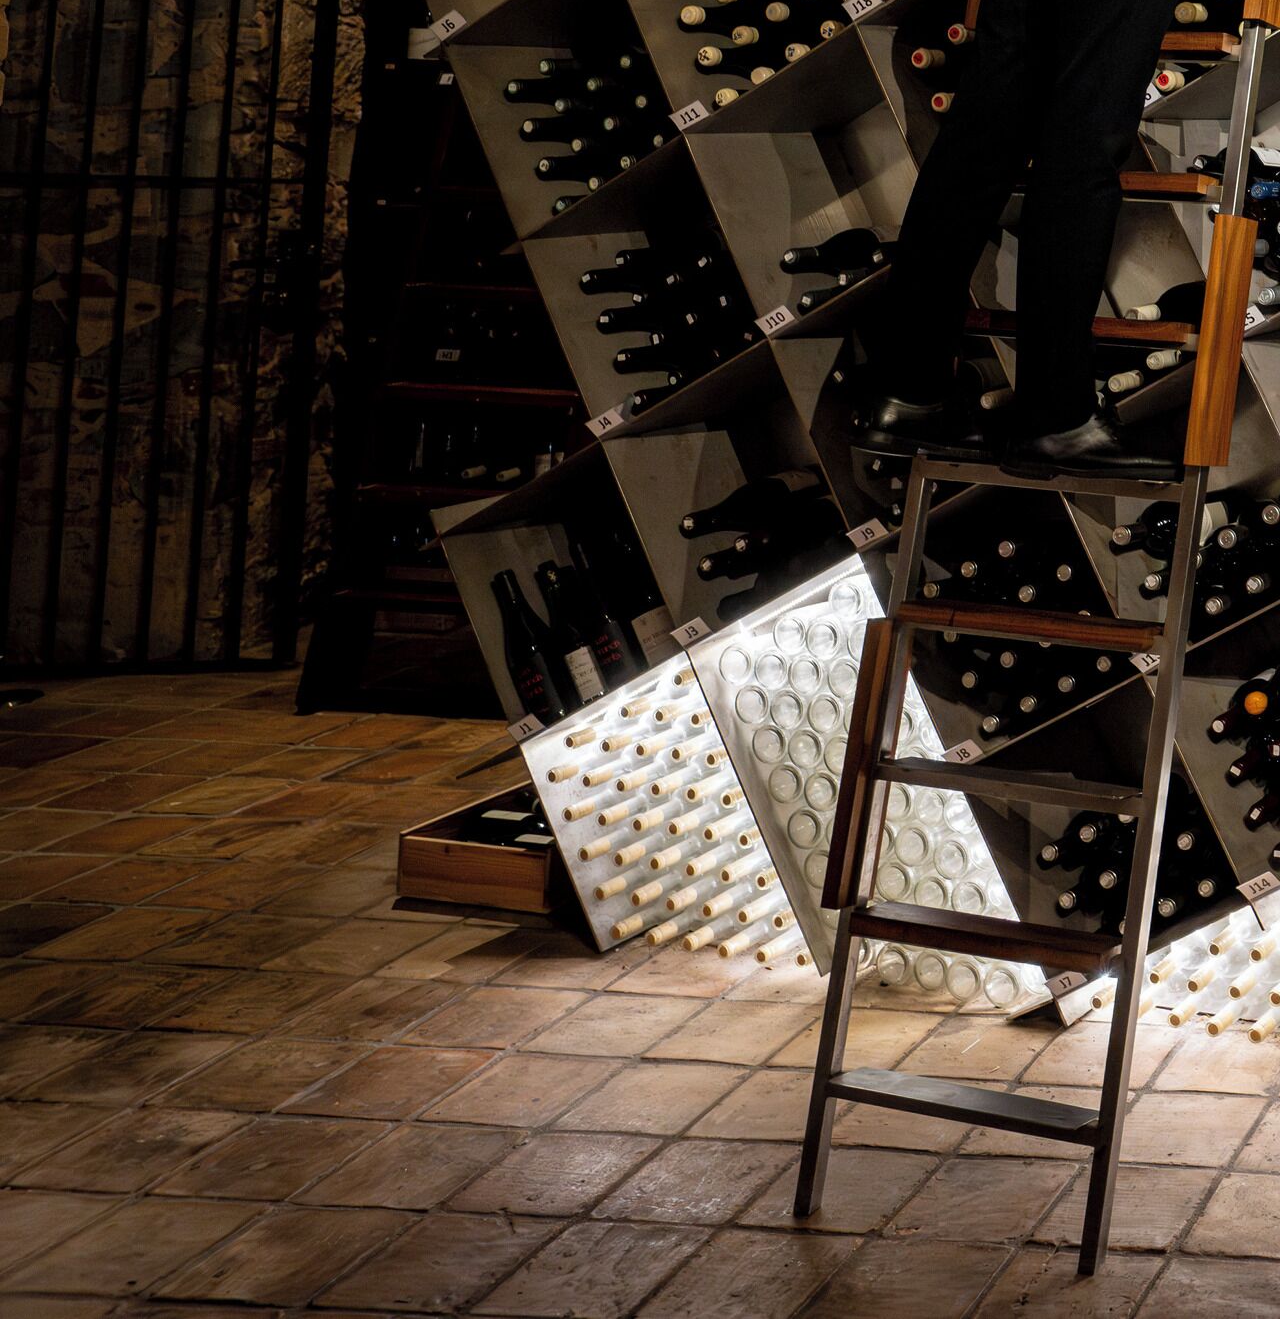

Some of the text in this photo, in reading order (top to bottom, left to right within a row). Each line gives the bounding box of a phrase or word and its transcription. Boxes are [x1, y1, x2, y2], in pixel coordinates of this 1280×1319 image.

[441, 19, 455, 33] J6
[680, 108, 701, 125] J11
[765, 312, 786, 329] J10
[598, 416, 612, 430] J4
[861, 527, 875, 541] J9
[684, 626, 699, 639] J3
[1141, 655, 1160, 667] J1
[520, 723, 533, 734] J1
[955, 748, 971, 761] J8
[1250, 878, 1271, 895] J14
[1059, 976, 1072, 989] J7
